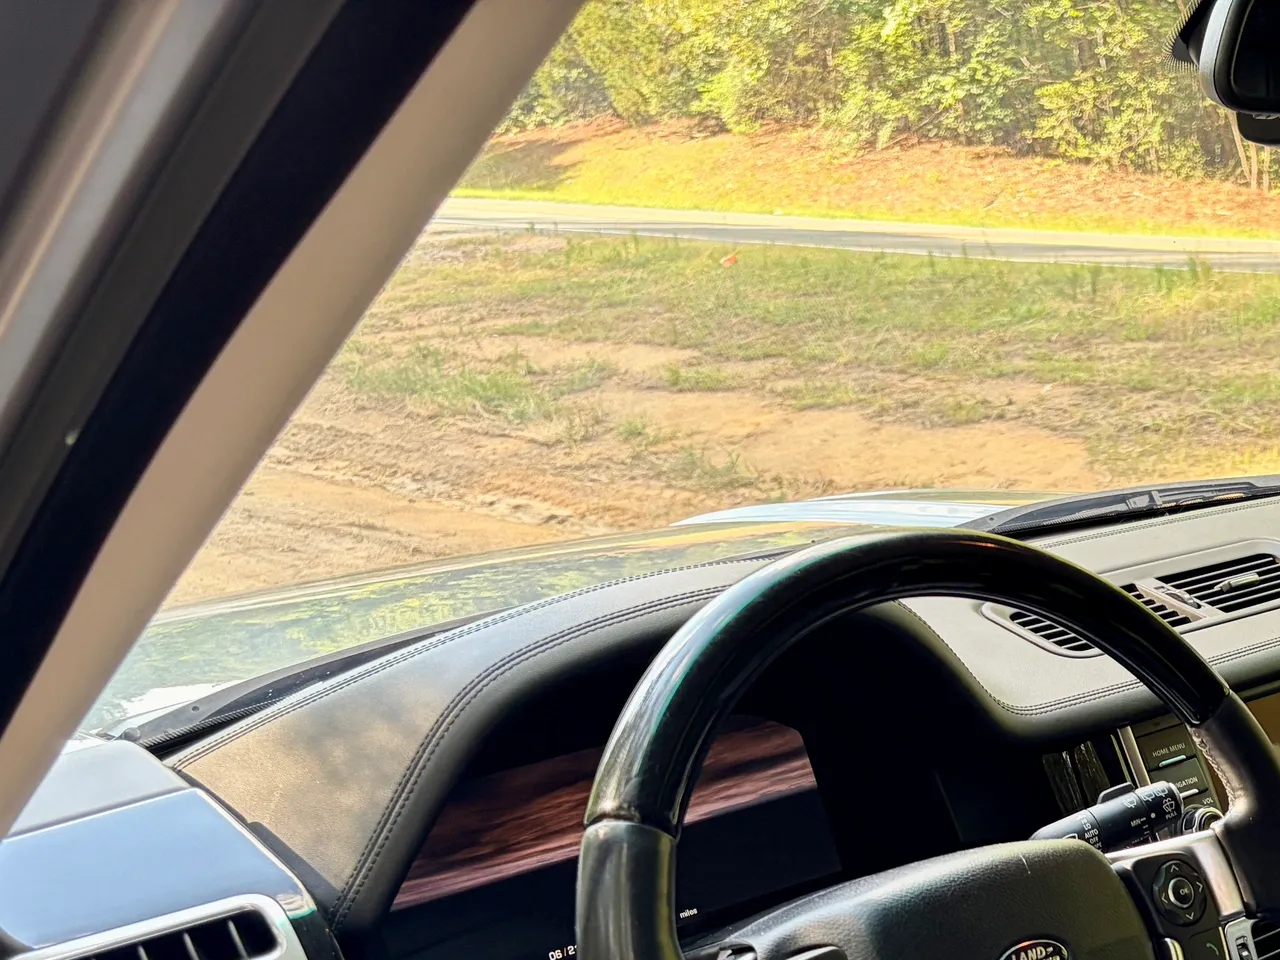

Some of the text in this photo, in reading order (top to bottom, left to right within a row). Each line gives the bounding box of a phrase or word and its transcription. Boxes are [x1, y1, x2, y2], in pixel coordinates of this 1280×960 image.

[1152, 743, 1186, 757] HOME MENU
[1202, 797, 1213, 805] VOL
[1165, 811, 1178, 820] PULL
[1085, 829, 1098, 839] AUTO
[679, 907, 698, 919] miles
[549, 945, 577, 960] 06/2
